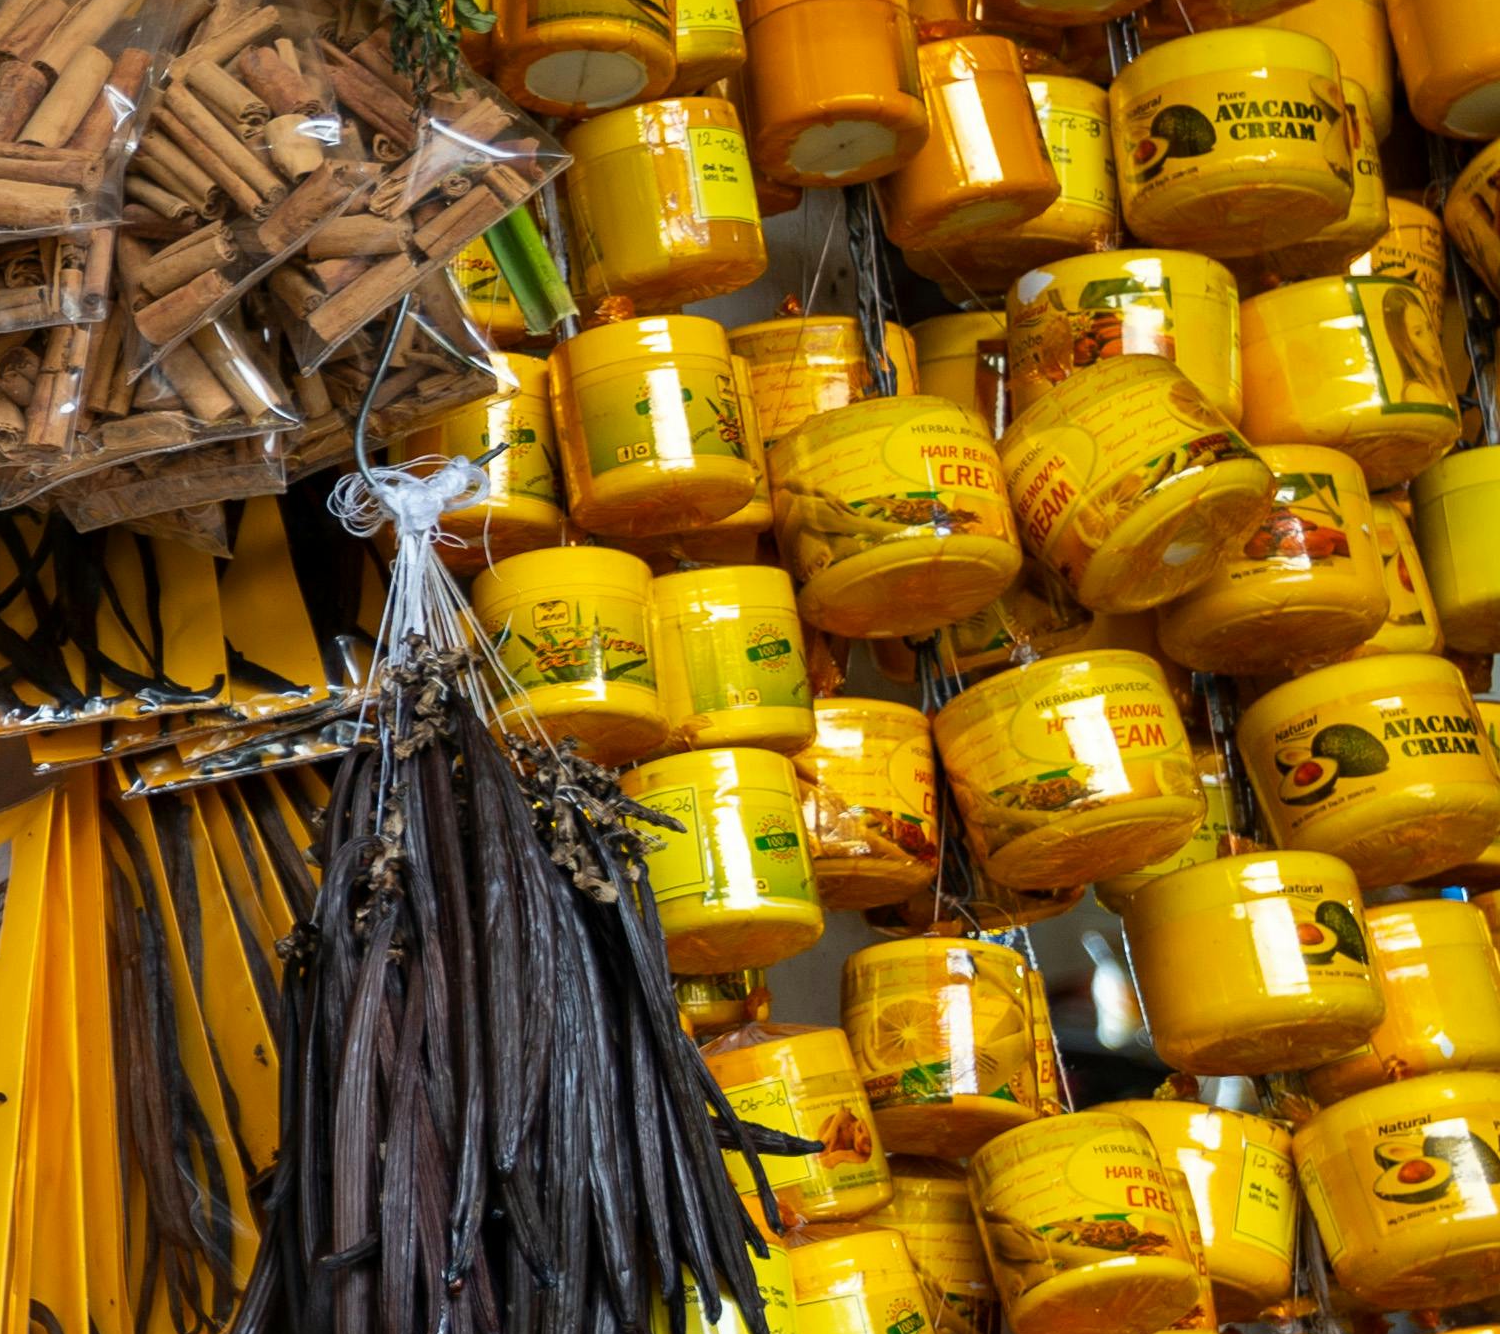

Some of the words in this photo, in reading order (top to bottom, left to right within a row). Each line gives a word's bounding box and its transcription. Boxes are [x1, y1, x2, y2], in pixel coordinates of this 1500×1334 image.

[1216, 91, 1246, 103] Pure
[1215, 100, 1322, 123] AVACADO
[1229, 123, 1317, 142] CREAM
[911, 424, 958, 435] HERBAL
[921, 445, 958, 459] HAIR
[536, 653, 587, 672] GEL
[1035, 690, 1088, 710] HERBAL
[1090, 682, 1152, 697] AYURVEDIC
[1378, 705, 1409, 718] Pure
[1274, 715, 1318, 744] Natural
[1383, 715, 1478, 740] AVACADO
[1401, 736, 1481, 757] CREAM
[1378, 1113, 1431, 1136] Natural
[1105, 1165, 1143, 1184] HAIR
